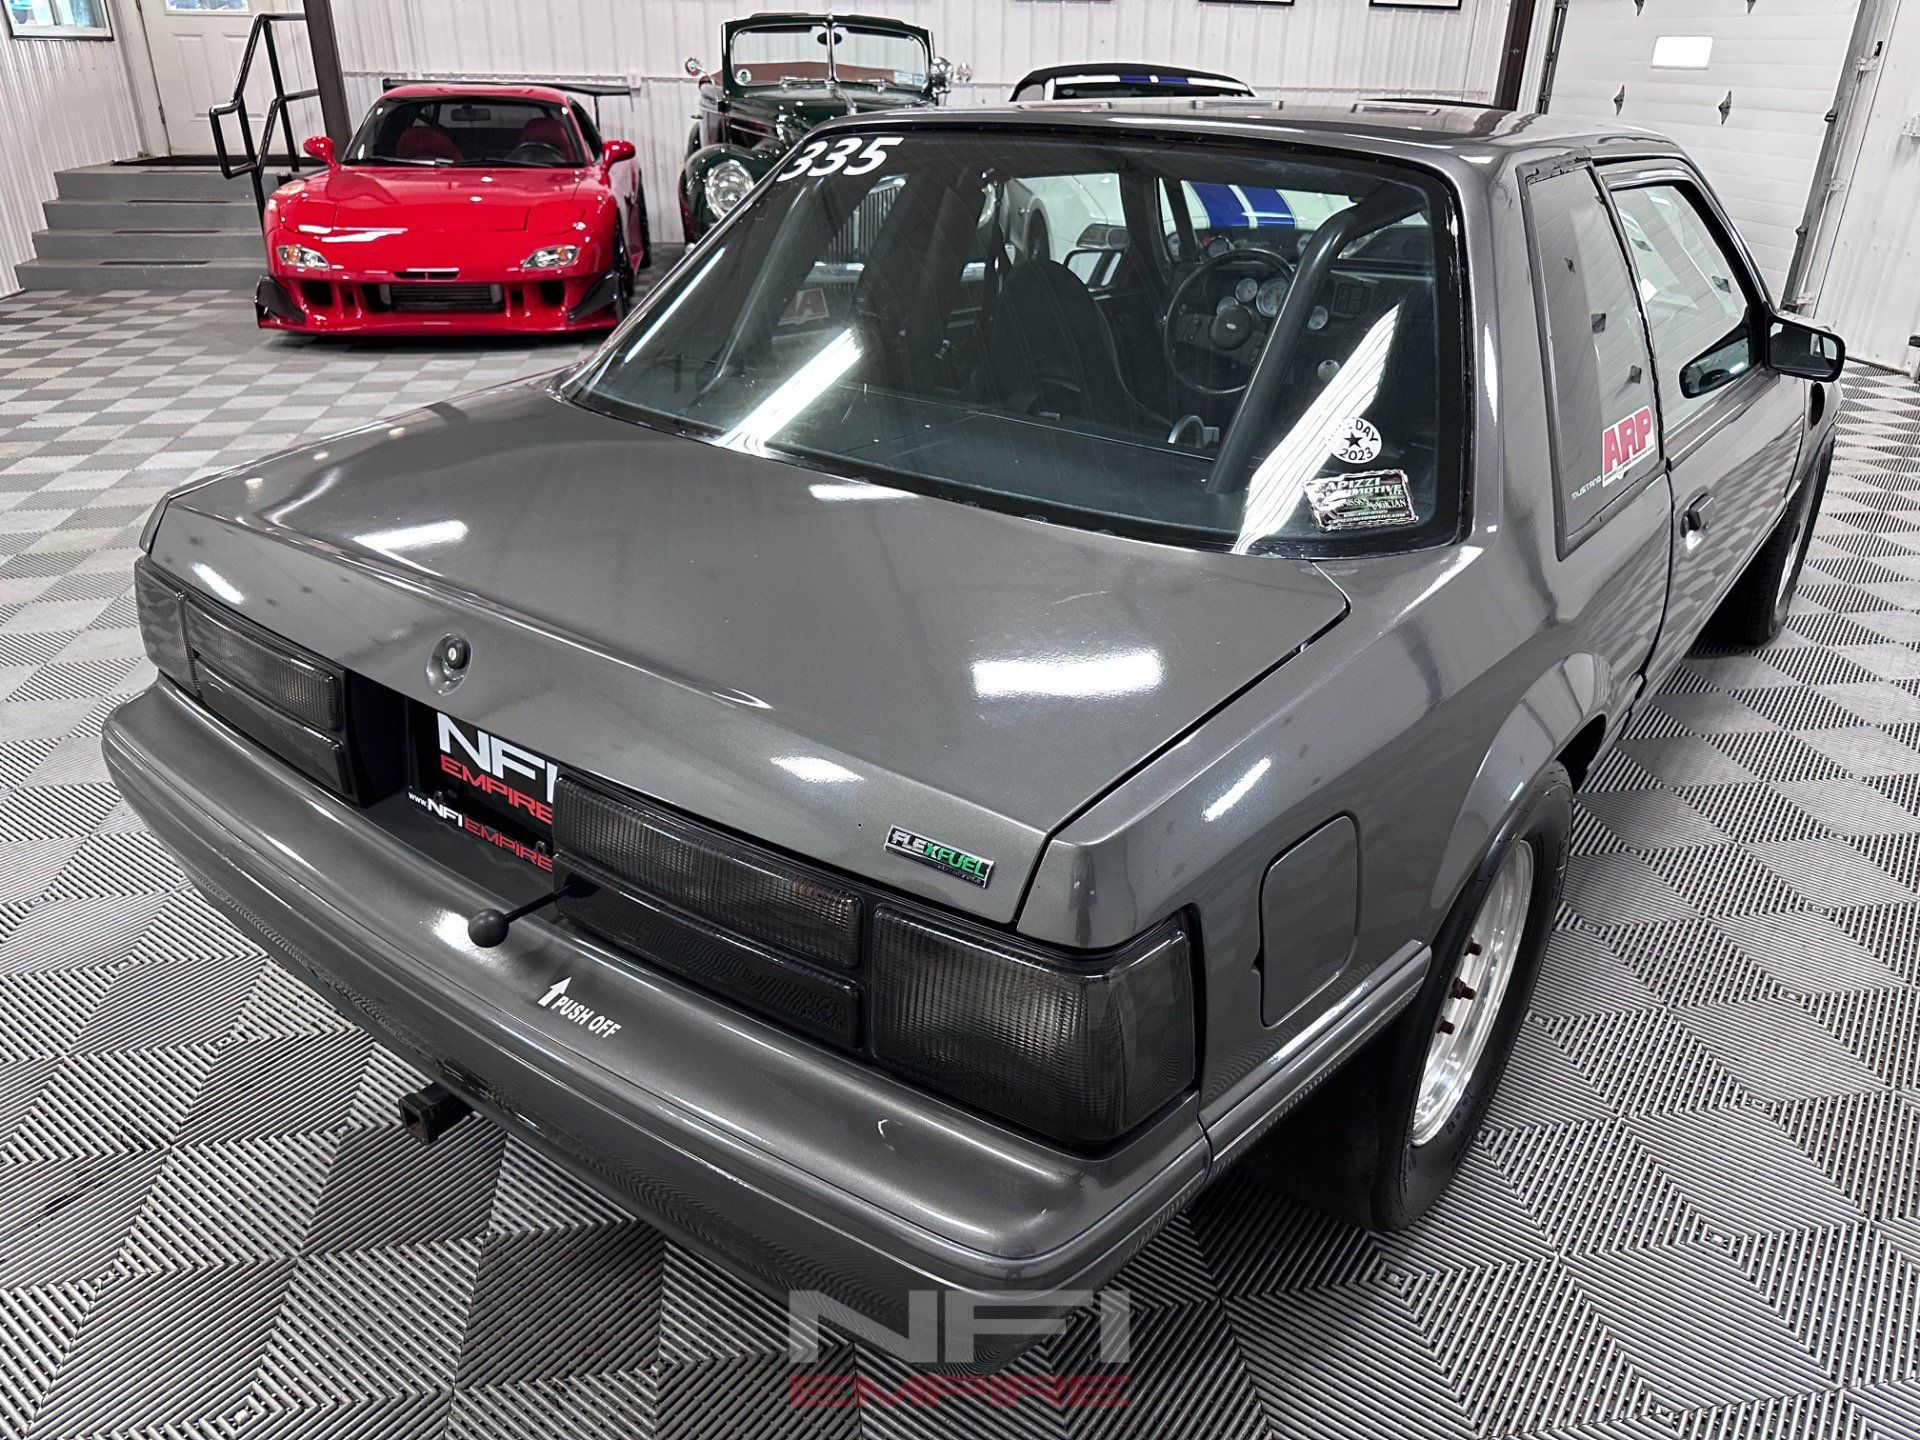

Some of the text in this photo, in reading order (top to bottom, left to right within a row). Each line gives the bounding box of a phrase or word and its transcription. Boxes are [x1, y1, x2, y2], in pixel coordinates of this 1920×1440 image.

[776, 137, 904, 182] 335
[1338, 447, 1374, 461] 2023
[1603, 408, 1652, 476] ARP
[1315, 484, 1404, 500] AOMOTIVE
[1571, 474, 1602, 501] MUSTANG
[437, 711, 558, 804] NFI
[440, 753, 553, 826] EMPIRE
[891, 829, 986, 877] FLEXFUEL
[551, 995, 622, 1038] PUSH OFF
